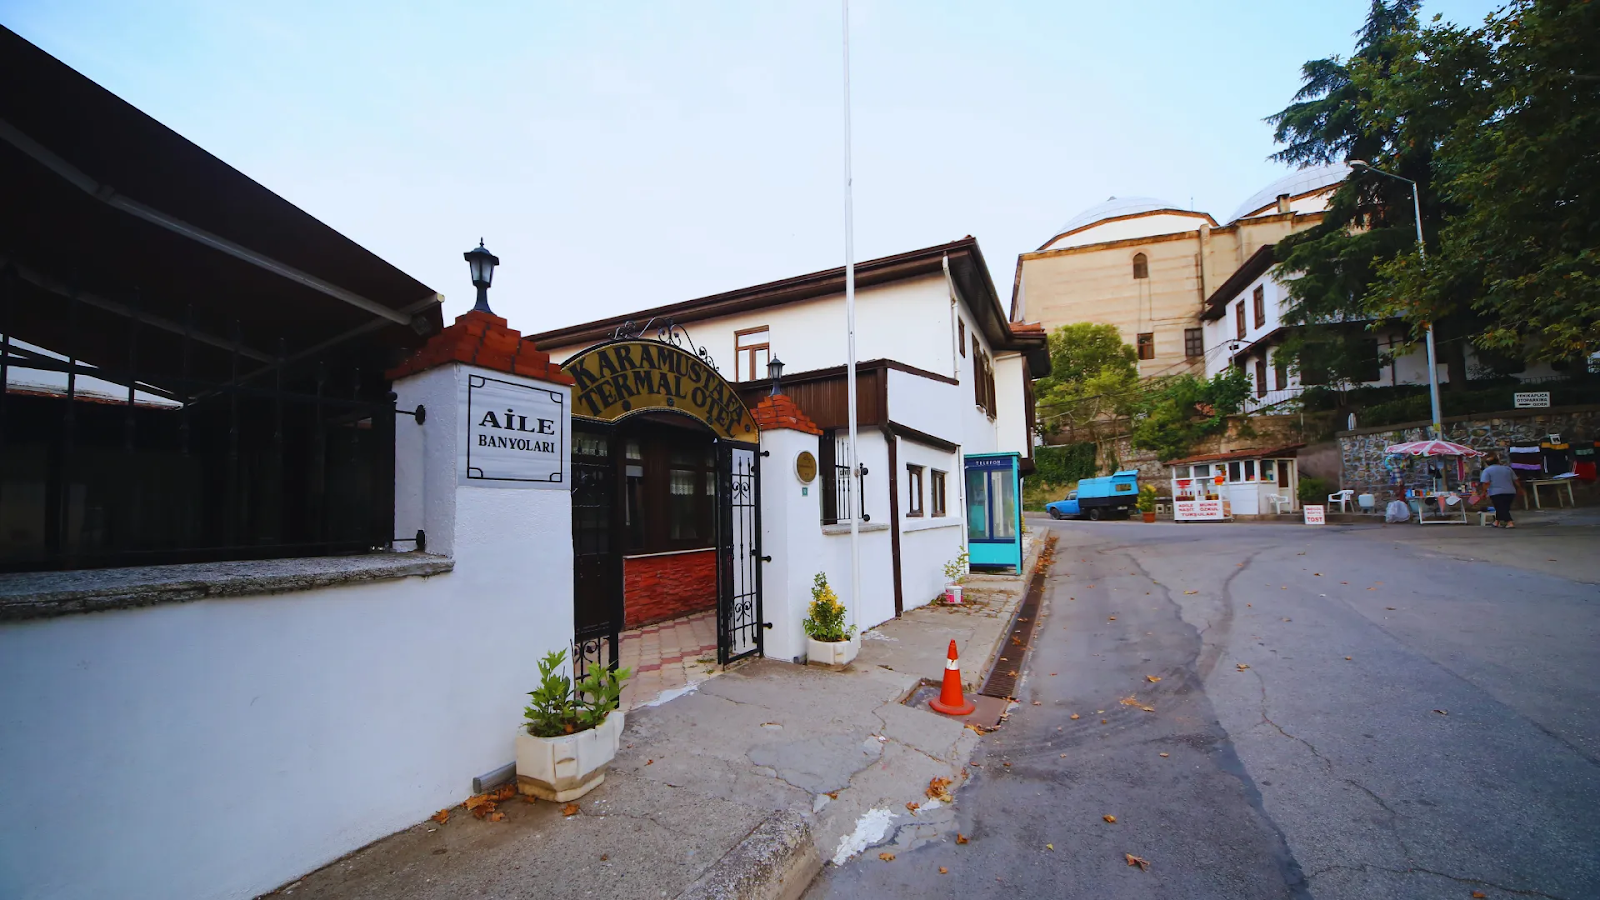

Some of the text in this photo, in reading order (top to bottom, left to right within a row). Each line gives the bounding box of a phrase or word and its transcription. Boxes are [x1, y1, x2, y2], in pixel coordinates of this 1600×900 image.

[568, 344, 744, 426] KARAMUSTAFA
[578, 370, 736, 438] TERMAL OTEL
[478, 408, 555, 435] AİLE
[478, 434, 555, 454] BANYOLARI
